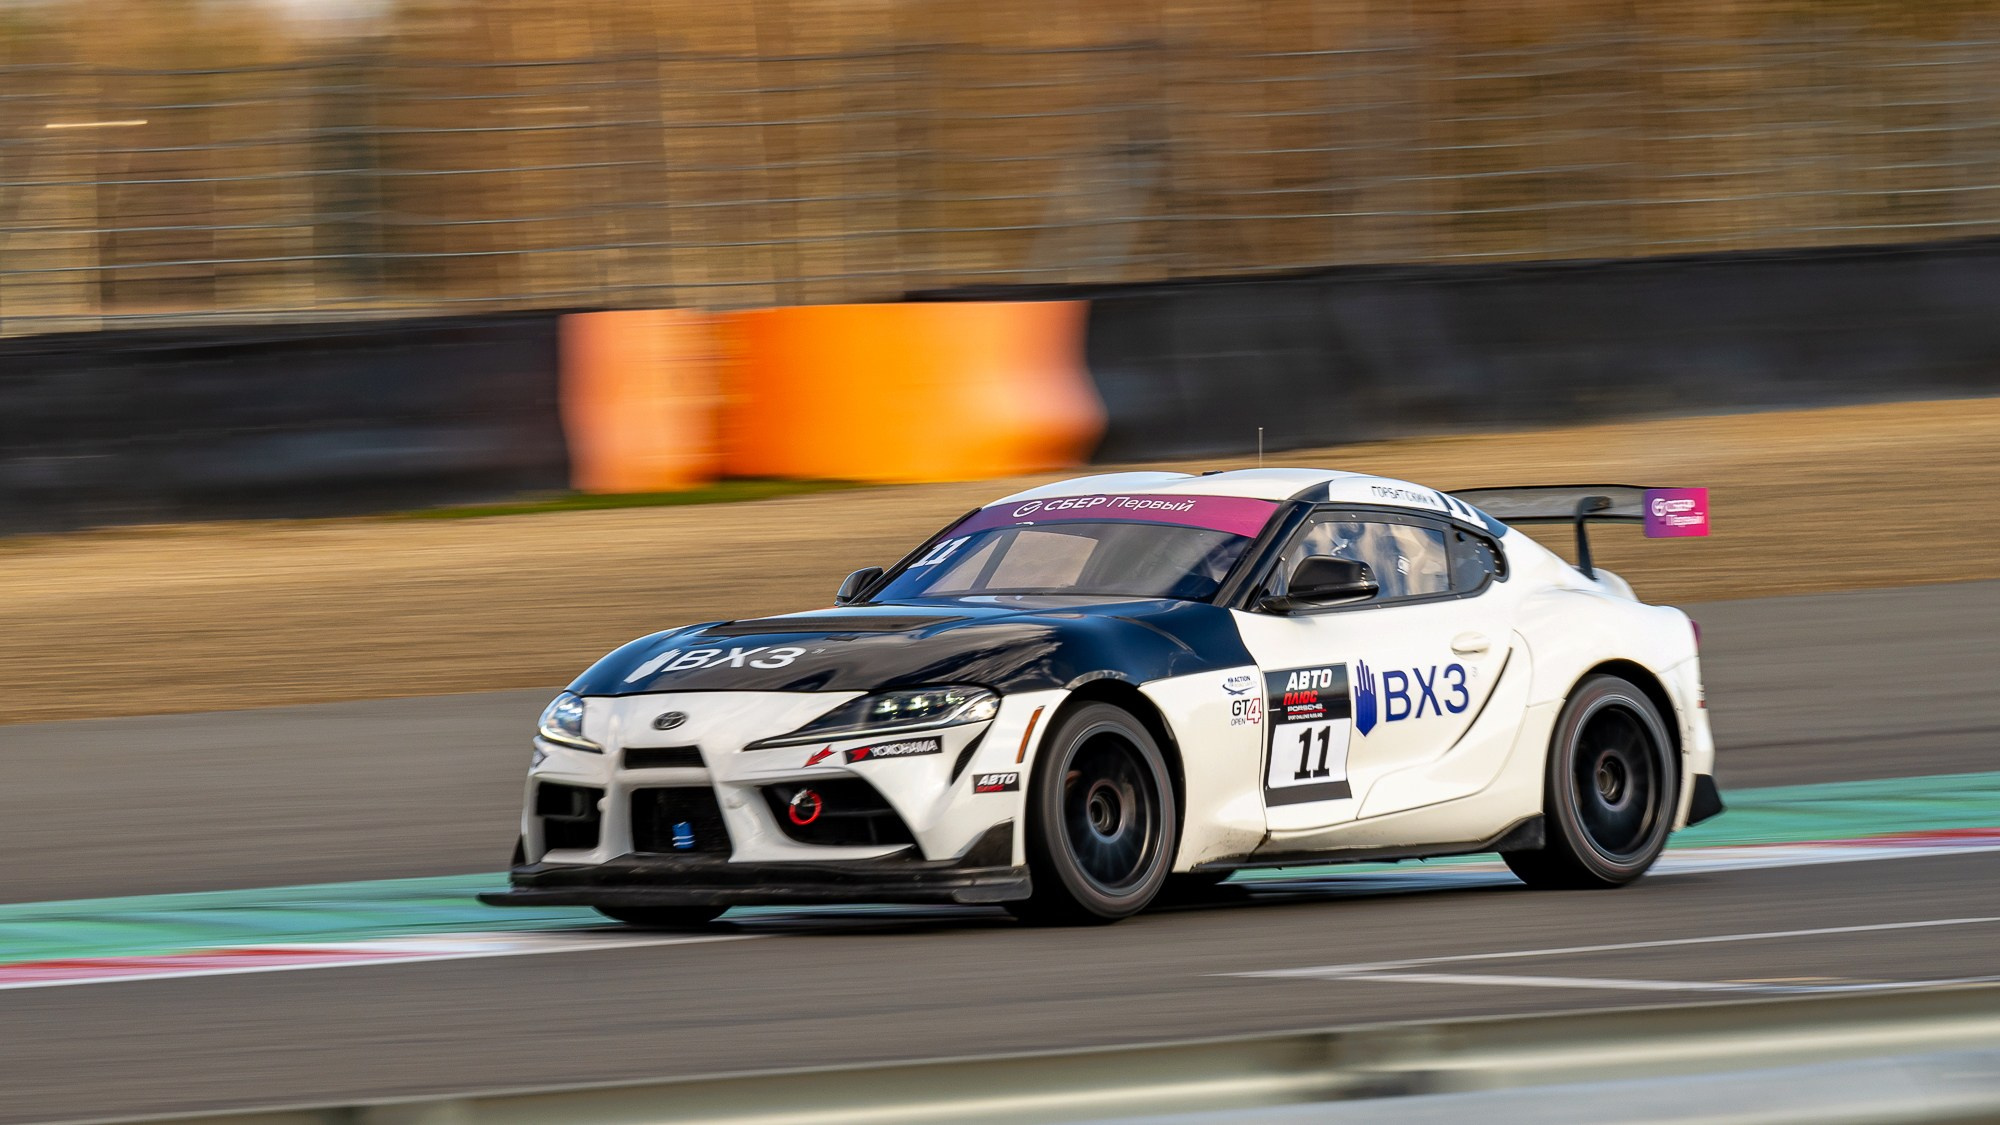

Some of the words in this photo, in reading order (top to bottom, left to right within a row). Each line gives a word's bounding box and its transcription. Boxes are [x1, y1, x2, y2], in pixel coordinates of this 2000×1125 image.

[1043, 497, 1106, 511] СБЕР
[1106, 496, 1196, 512] Первый
[907, 535, 972, 570] 11
[661, 646, 807, 673] BX3
[1285, 668, 1332, 691] АВТО
[1283, 690, 1318, 706] ПЛЮС
[1382, 663, 1470, 723] BX3
[1231, 718, 1246, 726] OPEN
[870, 739, 938, 757] YOKOHAMA
[1294, 725, 1331, 780] 11
[977, 773, 1018, 786] АВТО
